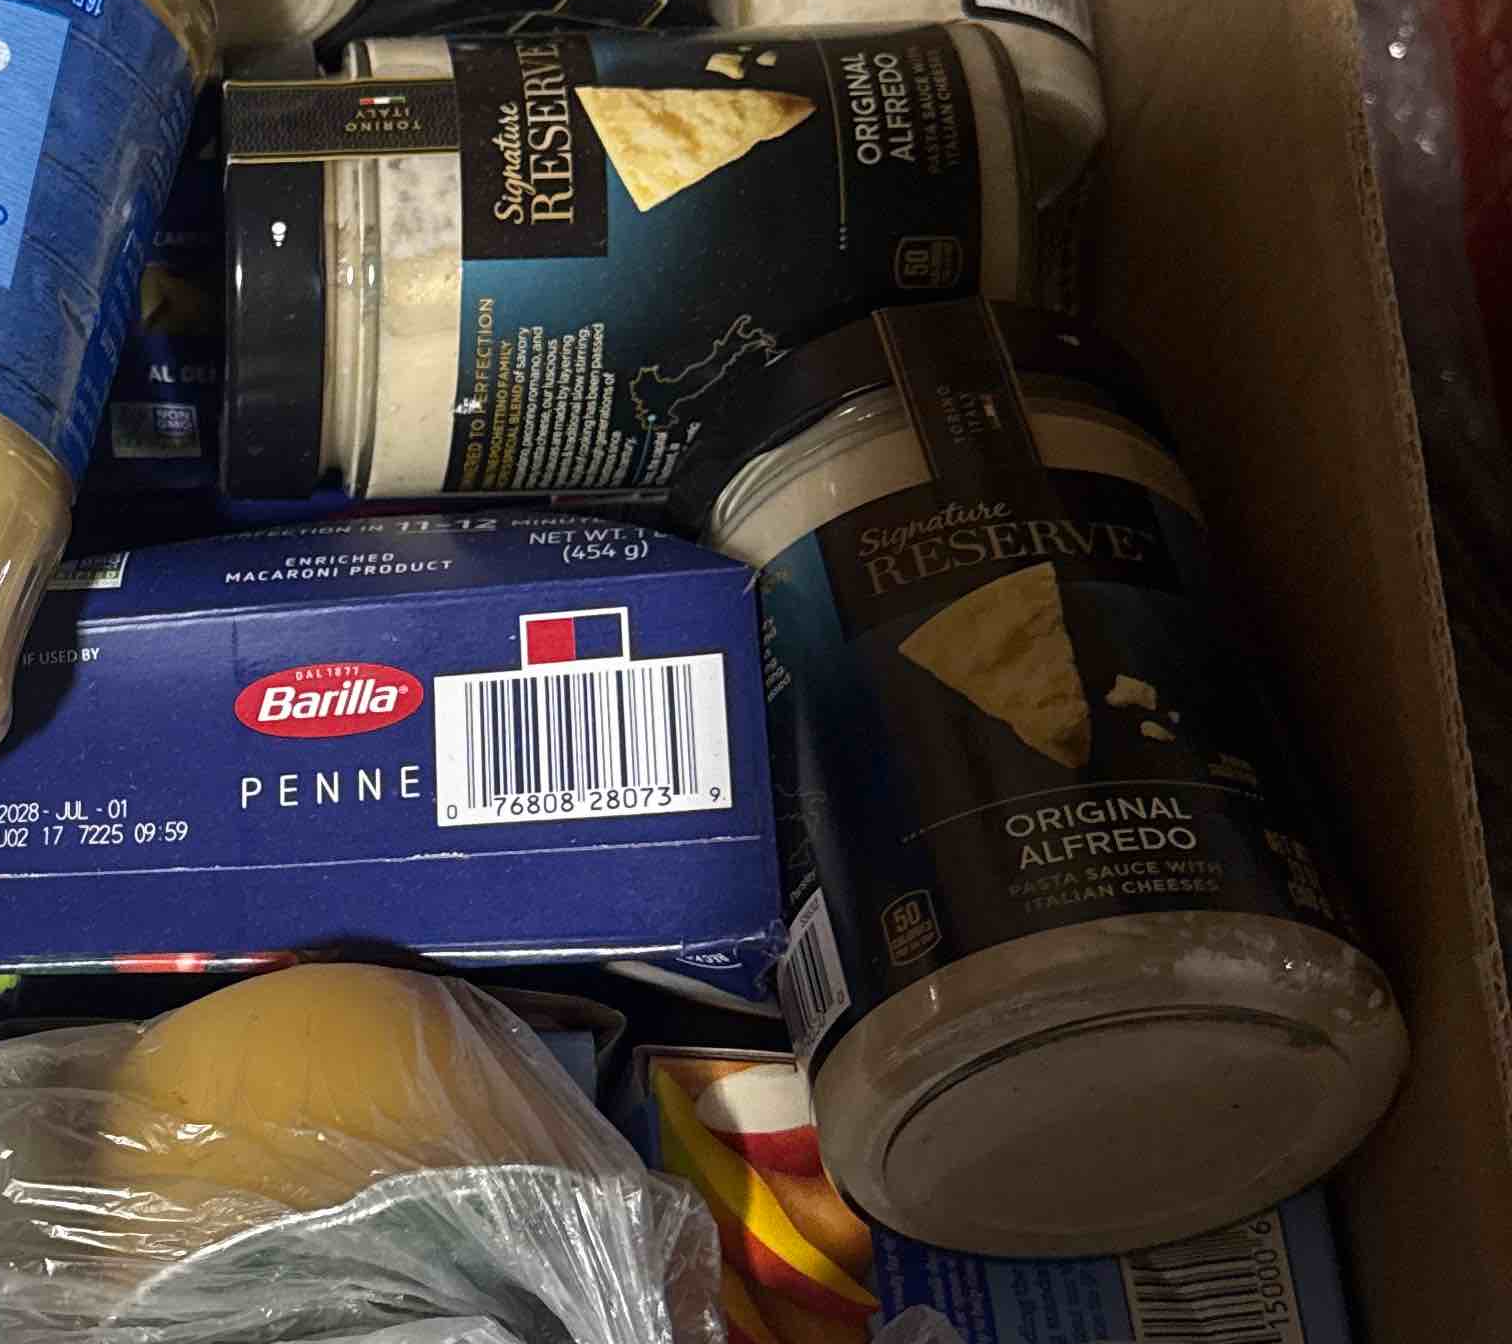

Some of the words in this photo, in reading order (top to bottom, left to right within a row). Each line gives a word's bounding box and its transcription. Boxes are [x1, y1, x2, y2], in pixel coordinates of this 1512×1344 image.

[844, 53, 886, 166] ORIGINAL
[873, 53, 914, 161] ALFREDO
[518, 39, 575, 225] RESERVE
[491, 102, 532, 224] Signature
[529, 530, 575, 544] NET
[584, 528, 625, 541] WT.
[562, 543, 616, 563] (454
[622, 536, 648, 560] g)
[860, 501, 1011, 559] Signature
[225, 567, 337, 582] MACARONI
[349, 560, 451, 575] PRODUCT
[285, 553, 393, 566] ENRICHED
[866, 523, 1143, 595] RESERVE
[81, 647, 101, 663] BY
[295, 668, 322, 680] DAL
[326, 666, 358, 676] 1877
[257, 682, 399, 723] Barilla
[240, 765, 421, 810] PENNE
[445, 804, 459, 820] 0
[494, 789, 573, 816] 76808
[589, 787, 672, 812] 28073
[43, 825, 63, 844] 17
[78, 823, 123, 844] 7225
[134, 820, 188, 843] 09:59
[1005, 797, 1192, 837] ORIGINAL
[1020, 826, 1196, 869] ALFREDO
